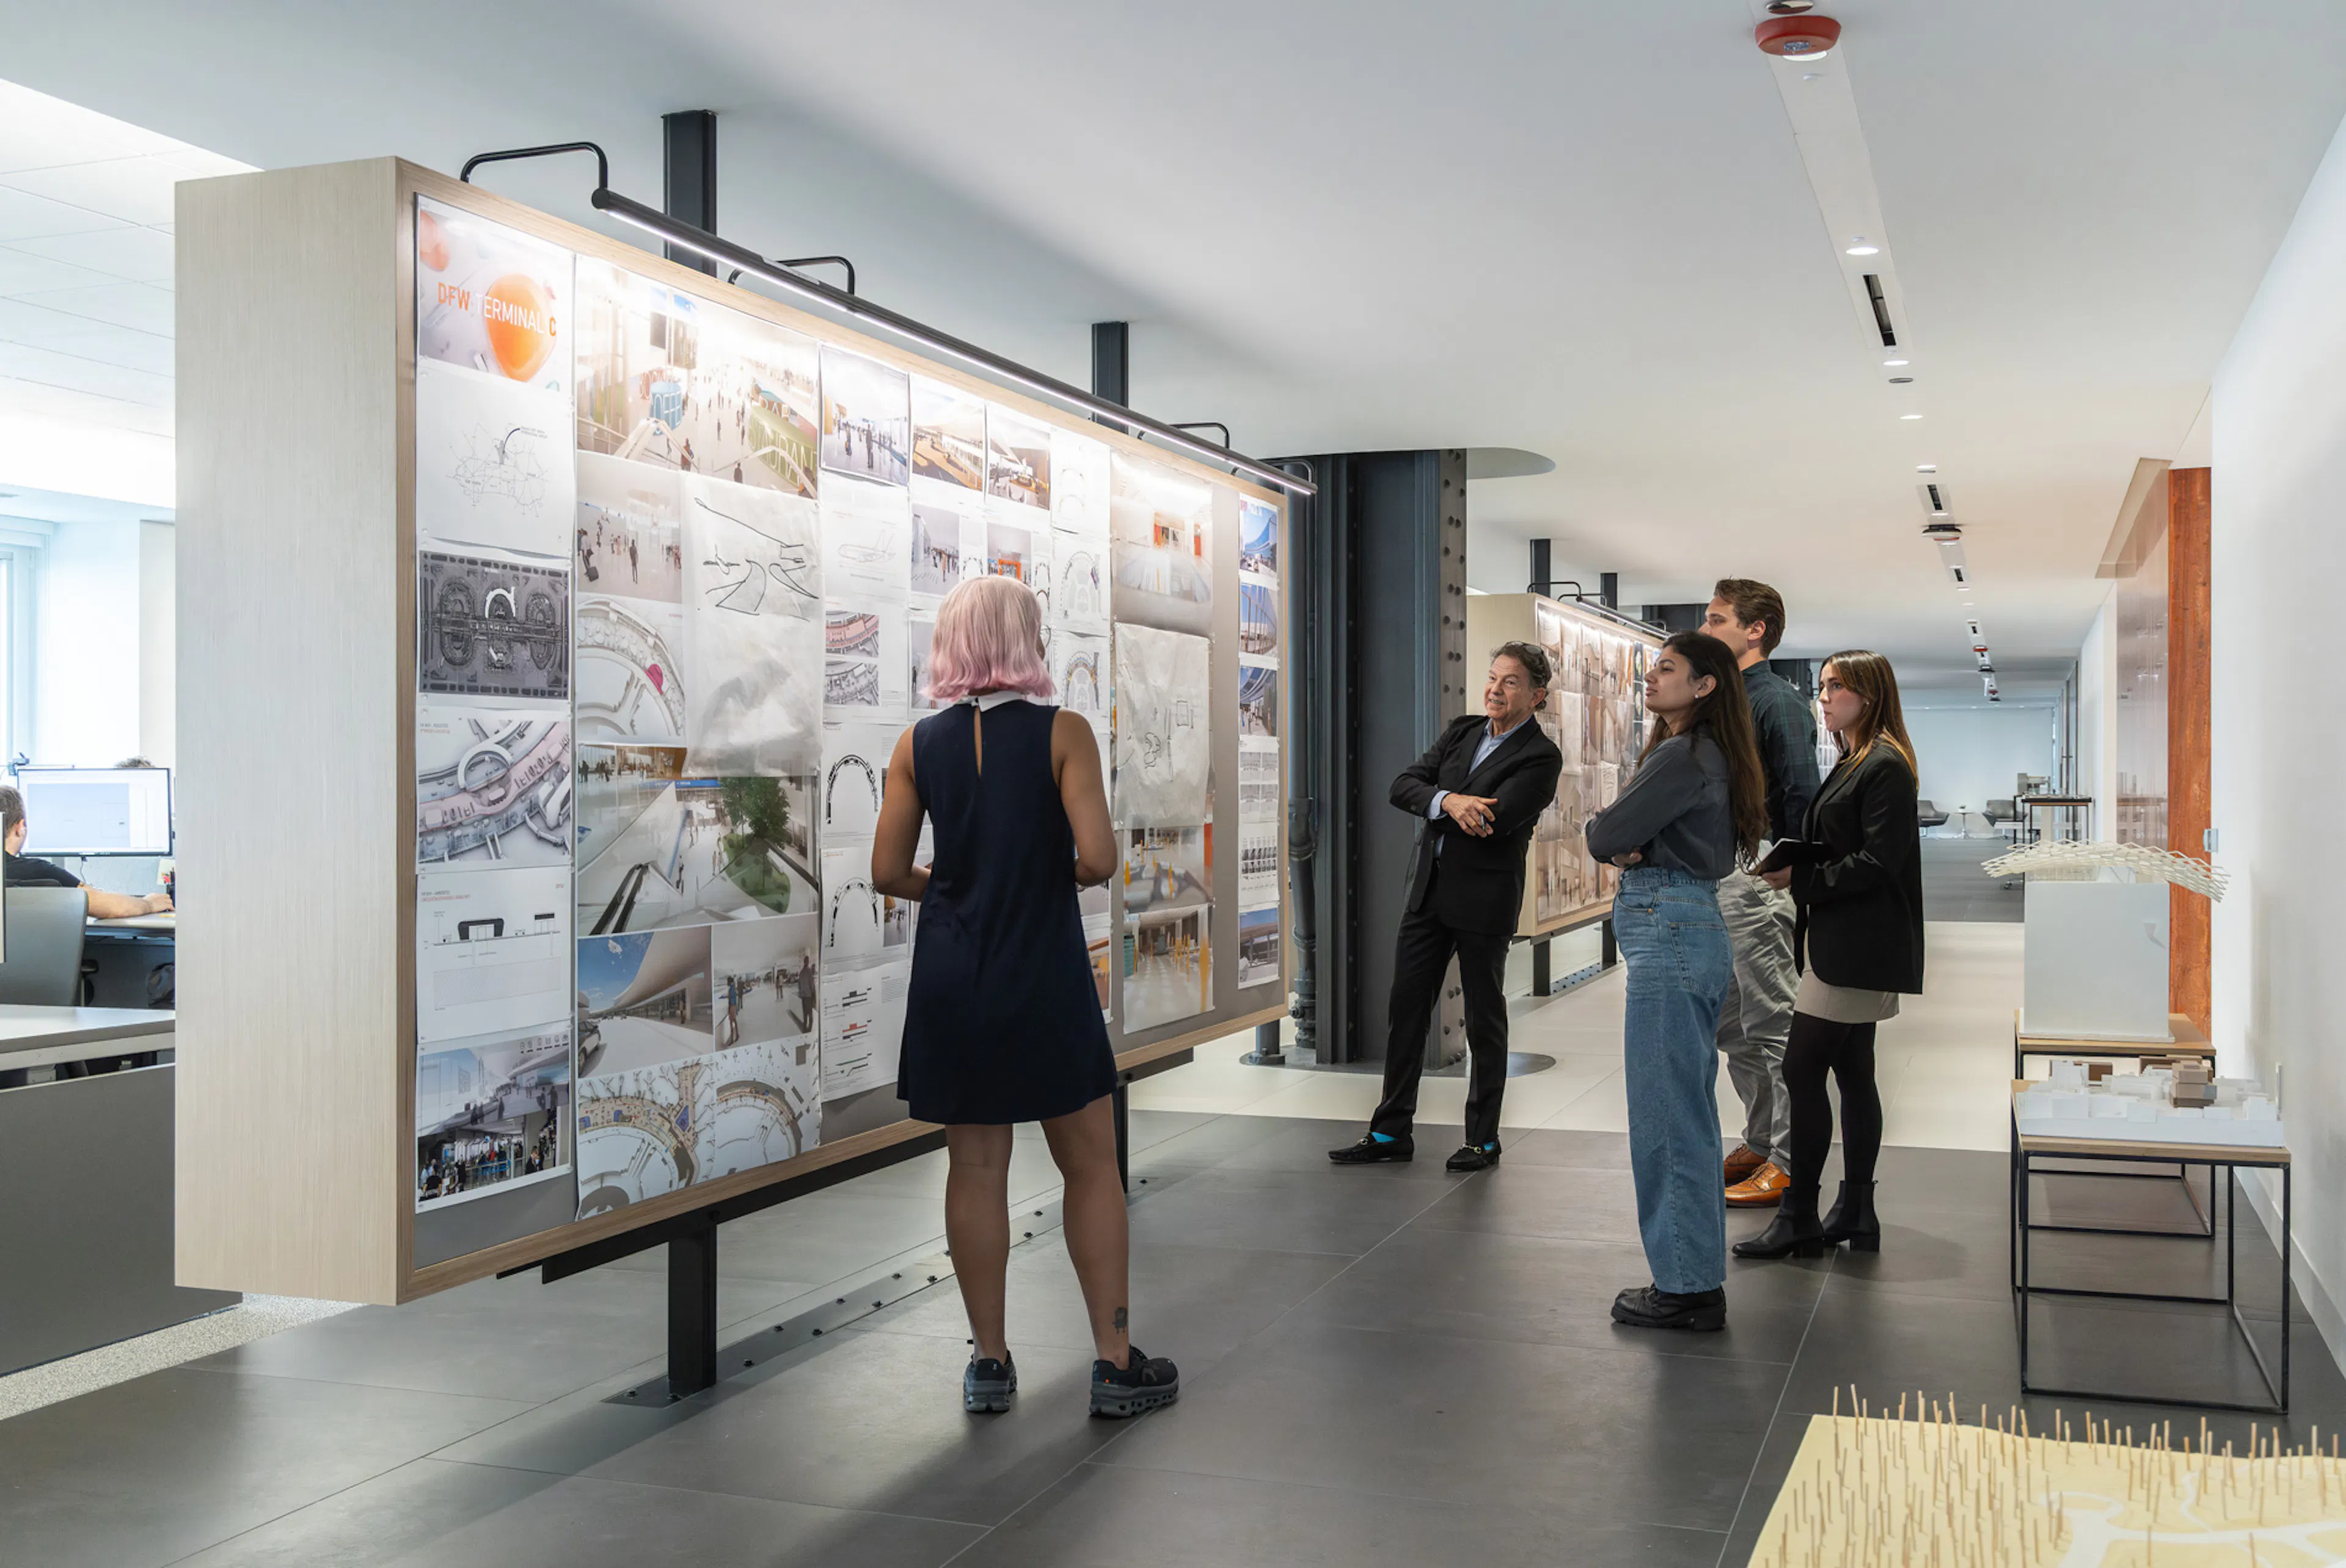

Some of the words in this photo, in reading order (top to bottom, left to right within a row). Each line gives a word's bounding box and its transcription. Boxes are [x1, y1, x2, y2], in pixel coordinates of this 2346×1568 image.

[437, 282, 470, 312] DFW
[475, 293, 545, 334] TERMINAL
[549, 317, 557, 337] C
